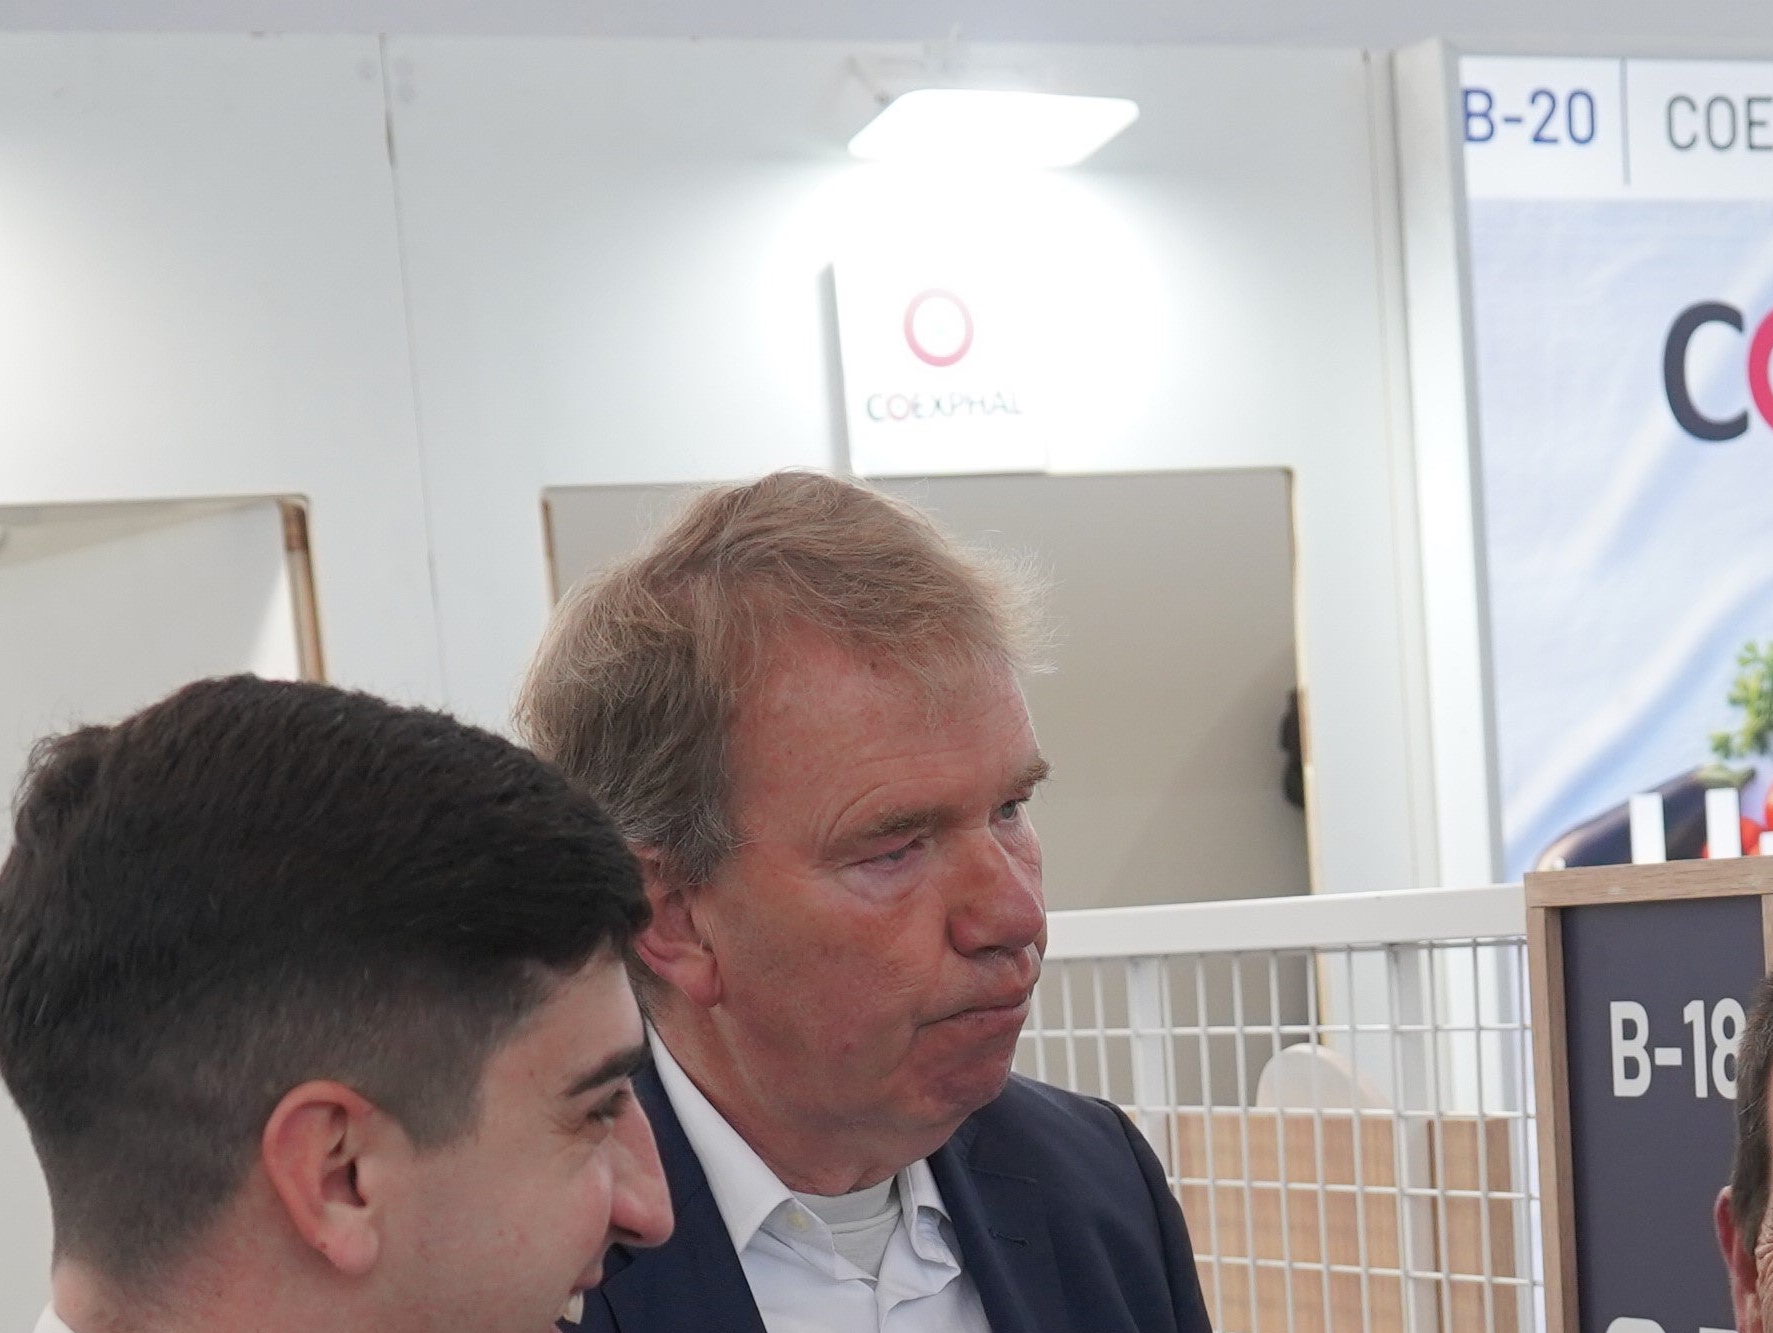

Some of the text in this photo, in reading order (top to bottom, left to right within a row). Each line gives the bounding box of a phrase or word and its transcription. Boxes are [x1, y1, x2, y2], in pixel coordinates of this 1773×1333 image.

[1461, 88, 1597, 146] B-20
[866, 389, 1025, 422] COEXPHAL
[1609, 997, 1747, 1100] B-18
